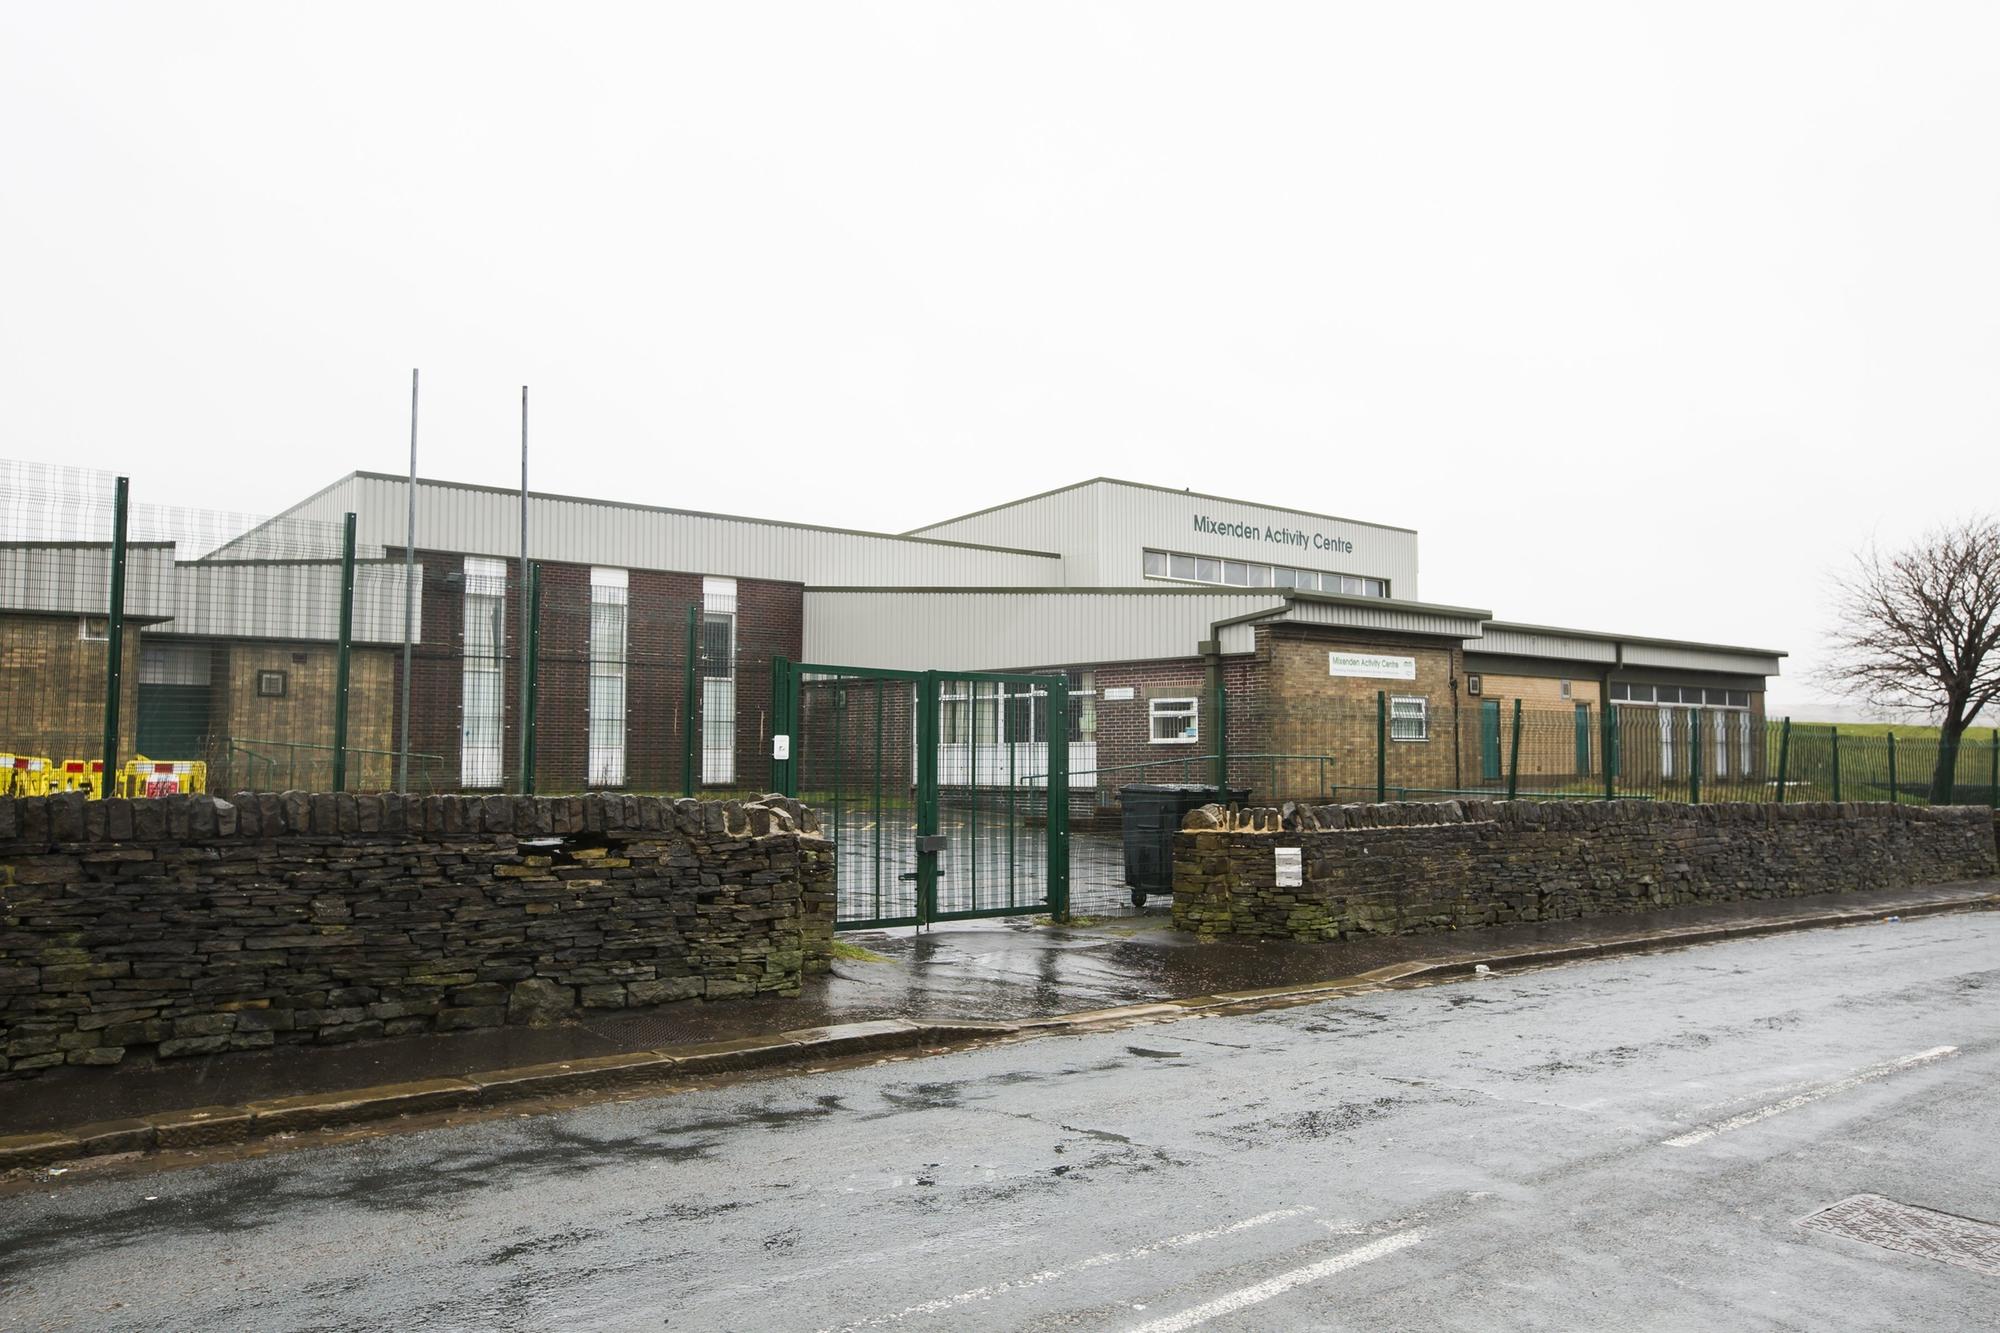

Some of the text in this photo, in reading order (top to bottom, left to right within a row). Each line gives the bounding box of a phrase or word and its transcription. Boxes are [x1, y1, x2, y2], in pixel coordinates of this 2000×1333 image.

[1194, 514, 1353, 554] Mixenden Activity Centre
[1332, 655, 1360, 666] Mixenden
[1361, 659, 1380, 669] Activity
[1381, 659, 1399, 668] Centre
